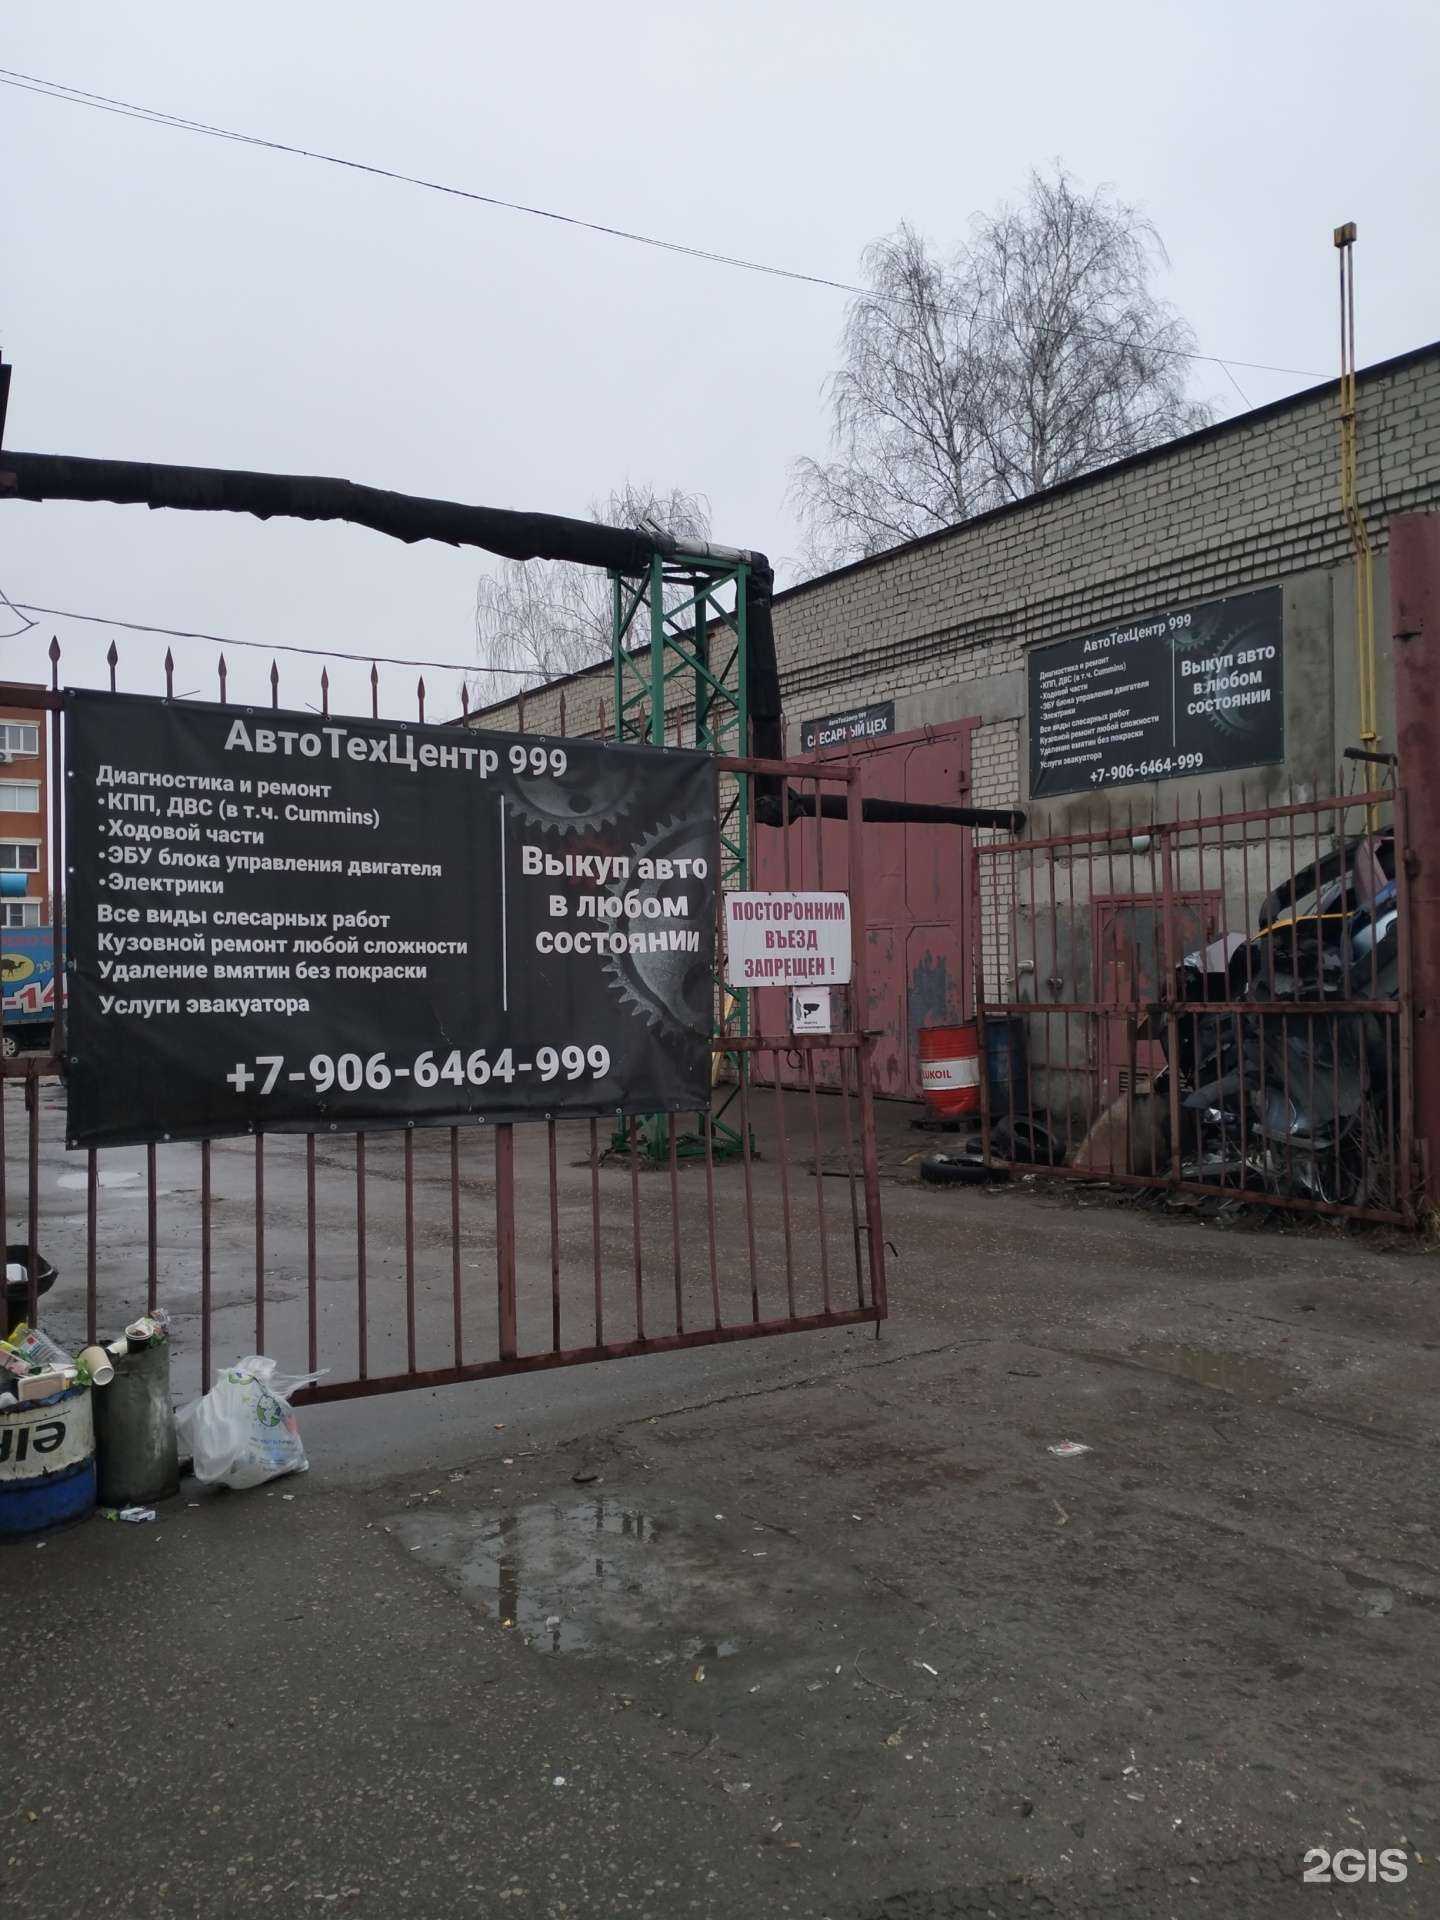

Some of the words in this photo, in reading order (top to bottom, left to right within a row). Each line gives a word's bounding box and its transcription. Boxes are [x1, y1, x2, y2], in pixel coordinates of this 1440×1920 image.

[1084, 623, 1165, 653] АвтоТехЦентр
[1169, 614, 1191, 630] 999
[1181, 655, 1233, 676] Выкуп
[1238, 646, 1275, 664] авто
[1193, 683, 1201, 695] в
[1203, 670, 1262, 693] любом
[1187, 689, 1271, 715] состоянии
[867, 718, 887, 735] ЦЕХ
[225, 719, 499, 778] АвтоТехЦентр
[508, 744, 569, 777] 999
[1091, 752, 1203, 782] +7-906-6464-999
[96, 765, 235, 793] Диагностика
[241, 776, 252, 794] и
[258, 777, 332, 802] ремонт
[166, 796, 213, 819] ДВС
[218, 800, 238, 820] (в
[243, 803, 280, 821] т.ч.
[285, 805, 380, 828] Cummins)
[205, 827, 265, 844] части
[157, 848, 221, 868] блока
[226, 854, 342, 875] управления
[347, 858, 442, 879] двигателя
[521, 846, 631, 886] Выкуп
[637, 855, 709, 881] авто
[97, 904, 140, 923] Все
[146, 907, 207, 929] виды
[212, 908, 327, 930] слесарных
[331, 910, 391, 931] работ
[549, 895, 569, 917] в
[575, 893, 688, 917] любом
[732, 902, 845, 921] ПОСТОРОННИМ
[97, 932, 206, 953] Кузовной
[211, 936, 287, 957] ремонт
[292, 934, 359, 954] любой
[364, 937, 468, 955] сложности
[535, 927, 700, 955] состоянии
[766, 930, 818, 951] ВЪЕЗД
[98, 961, 209, 981] Удаление
[213, 962, 291, 980] вмятин
[295, 962, 331, 980] без
[335, 962, 427, 982] покраски
[744, 957, 825, 978] ЗАПРЕЩЕН
[99, 995, 181, 1017] Услуги
[186, 996, 310, 1016] эвакуатора
[226, 1044, 611, 1095] +7-906-6464-999
